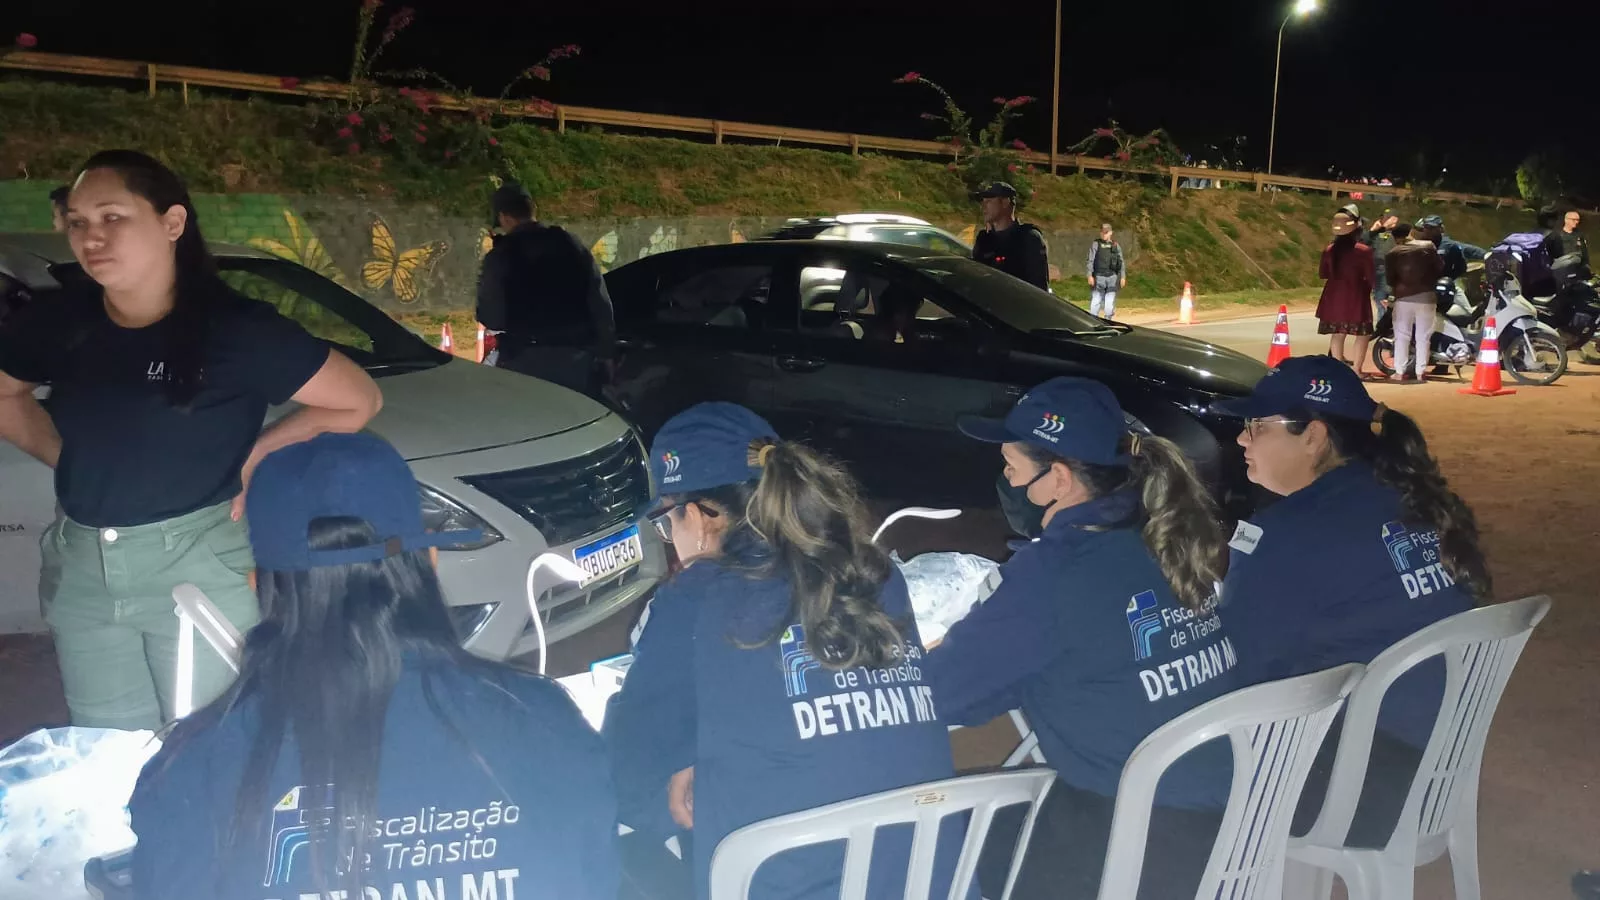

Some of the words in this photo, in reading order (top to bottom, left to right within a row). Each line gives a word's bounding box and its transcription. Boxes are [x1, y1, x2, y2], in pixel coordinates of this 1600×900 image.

[1422, 548, 1437, 562] de
[1400, 562, 1456, 600] DETR
[1170, 629, 1187, 649] de
[834, 669, 859, 688] de
[1139, 643, 1224, 702] DETRAN
[792, 688, 910, 740] DETRAN
[908, 685, 937, 722] MT
[383, 832, 498, 871] Trânsito
